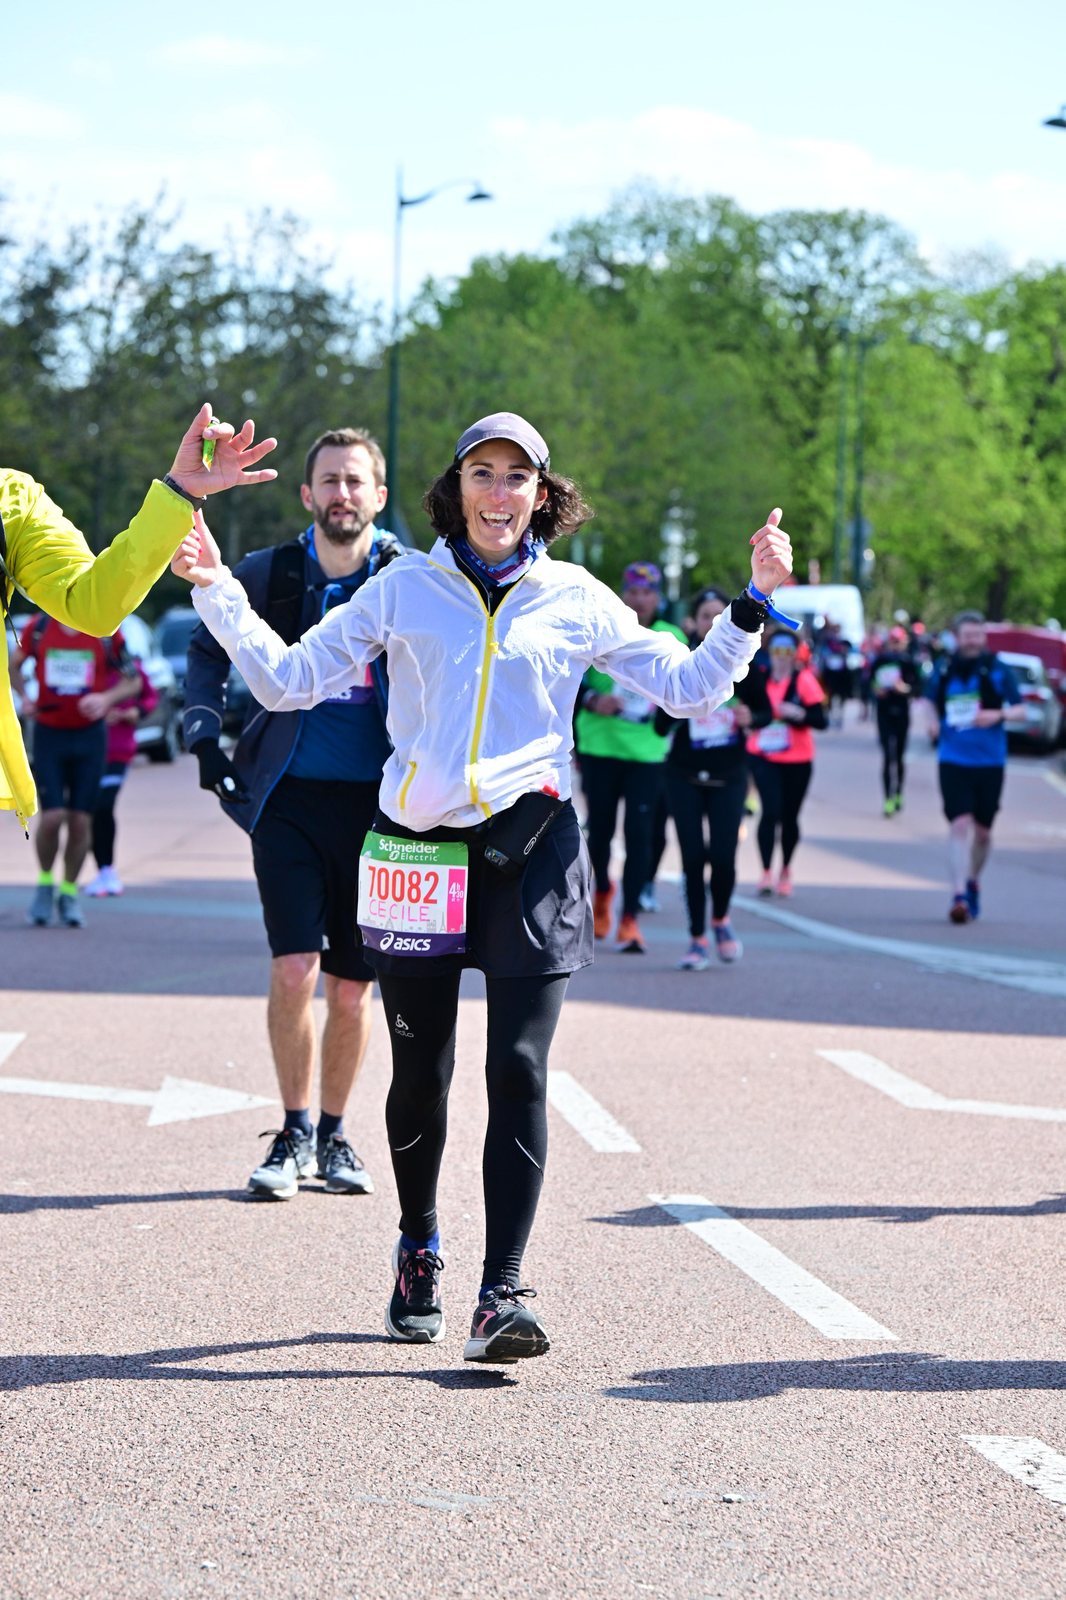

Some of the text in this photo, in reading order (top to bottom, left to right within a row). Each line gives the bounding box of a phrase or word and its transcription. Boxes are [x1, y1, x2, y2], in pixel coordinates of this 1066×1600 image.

[379, 838, 439, 854] Schneider
[400, 853, 438, 862] Electric
[368, 865, 439, 905] 70082
[368, 899, 430, 922] CECILE
